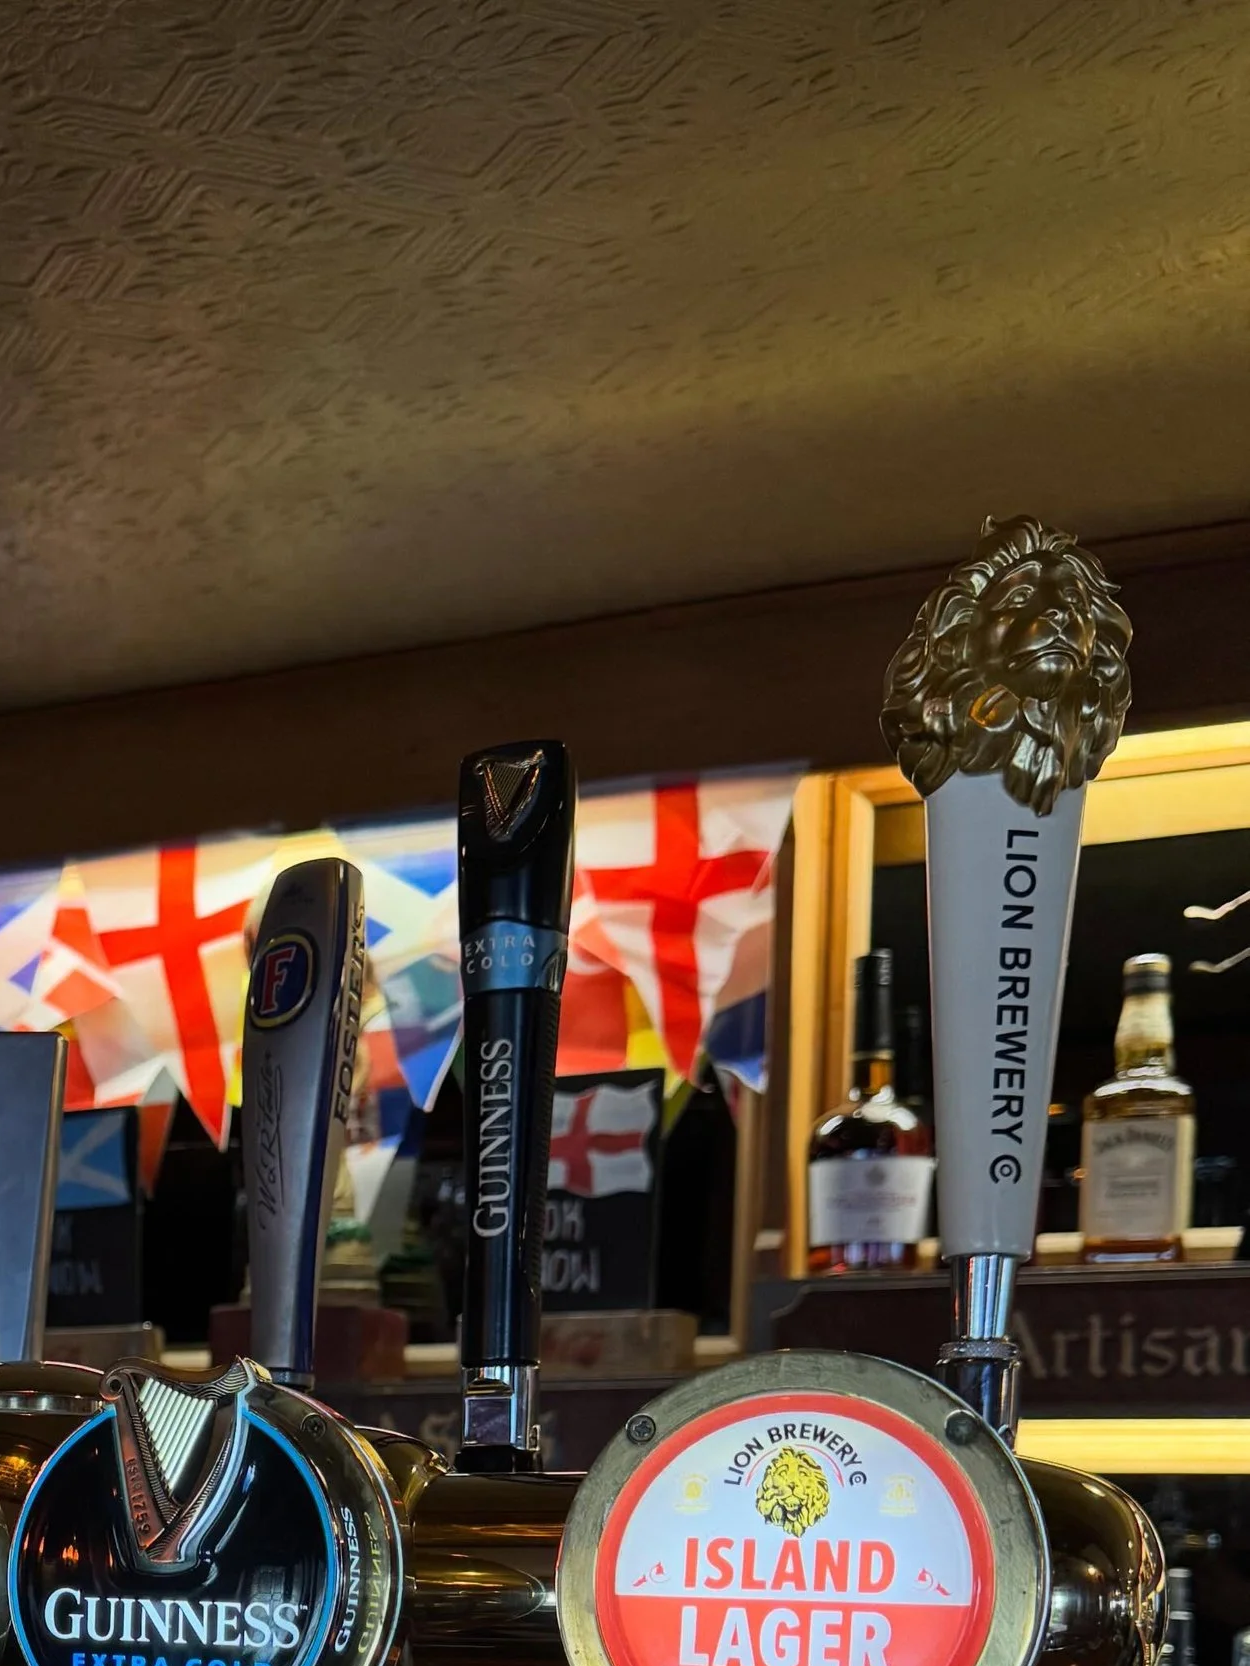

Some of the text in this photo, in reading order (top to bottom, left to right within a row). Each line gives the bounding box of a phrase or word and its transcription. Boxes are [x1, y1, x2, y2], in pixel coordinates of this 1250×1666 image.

[1001, 829, 1039, 930] LION
[464, 935, 535, 957] EXTRA
[466, 953, 534, 974] COLD
[260, 945, 297, 1016] F
[991, 947, 1032, 1145] BREWERY
[472, 1038, 513, 1238] GUINNESS
[724, 1437, 764, 1486] LION
[767, 1423, 862, 1467] BREWERY
[334, 1506, 360, 1652] GUINNESS
[683, 1537, 896, 1595] ISLAND
[44, 1587, 303, 1650] GUINNESS
